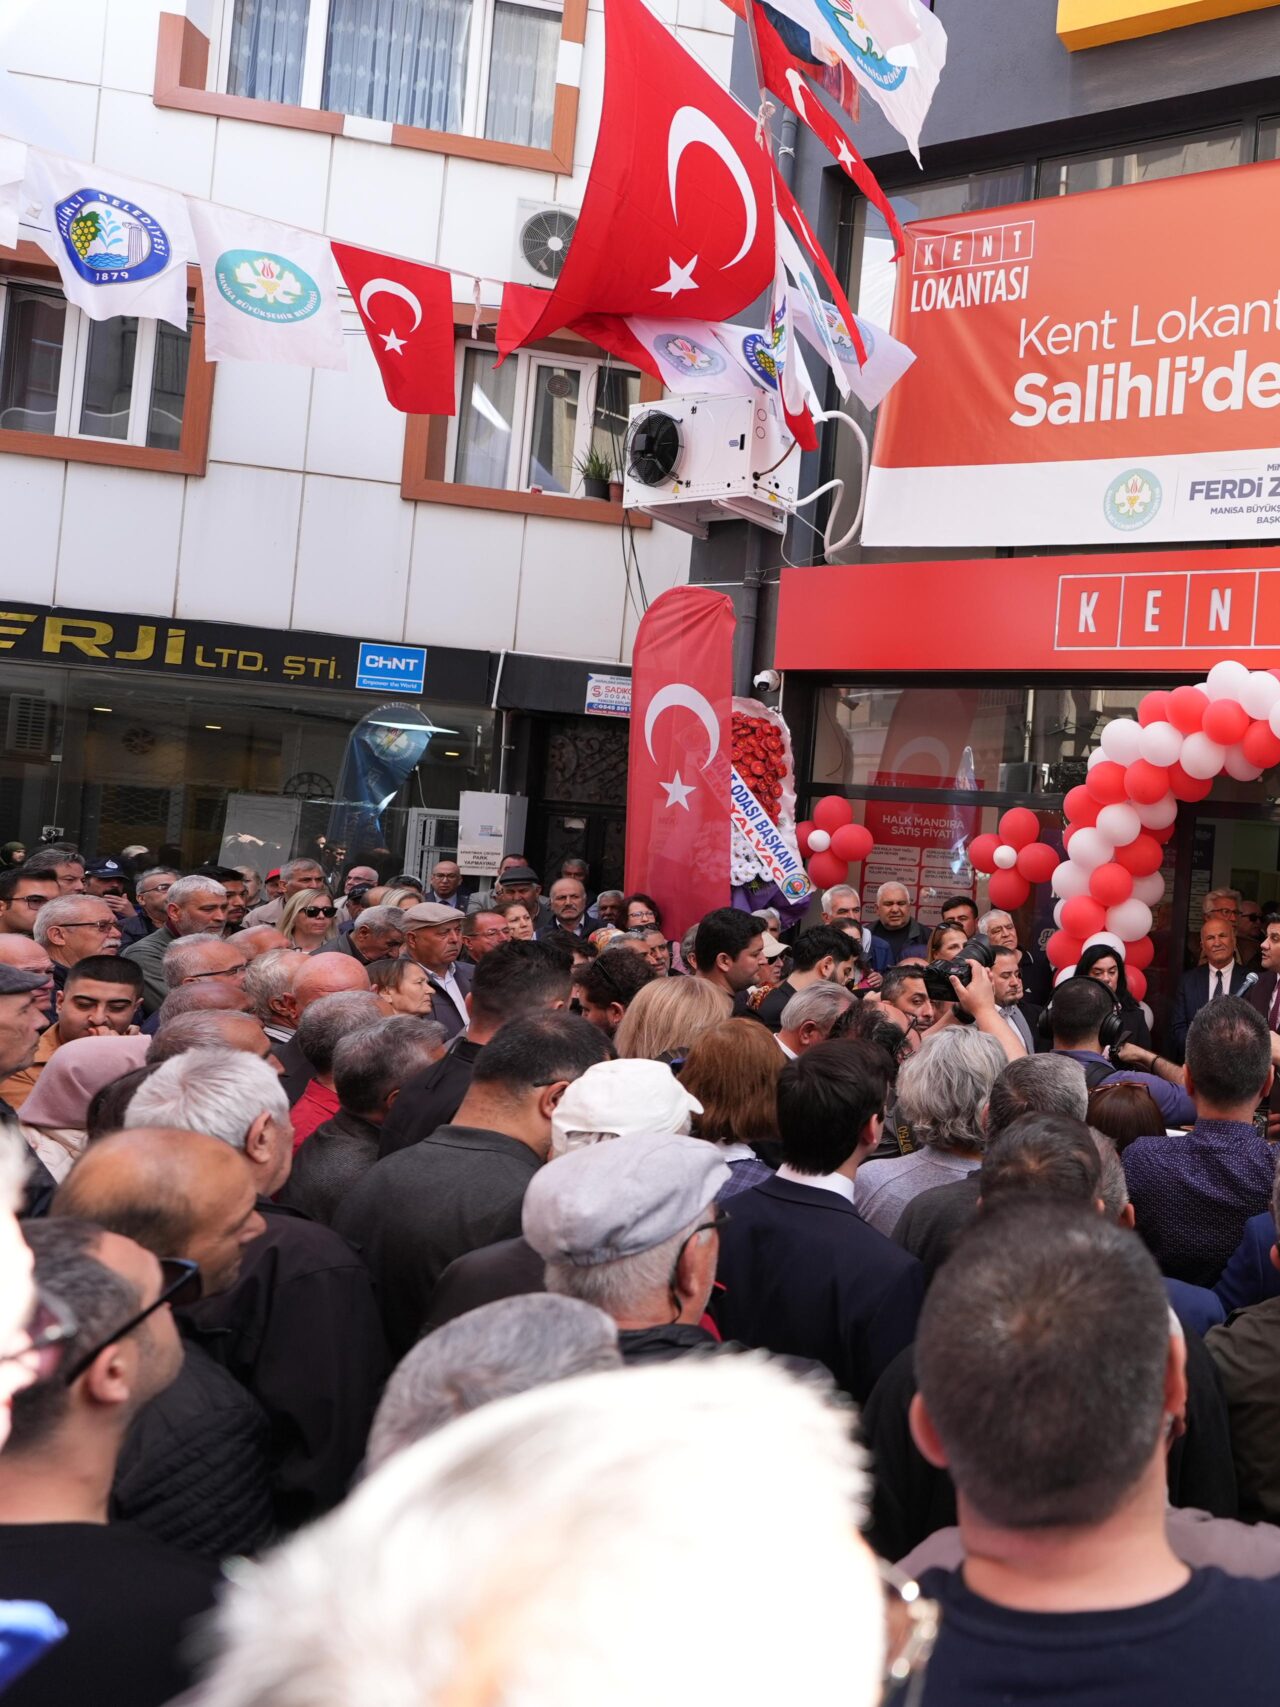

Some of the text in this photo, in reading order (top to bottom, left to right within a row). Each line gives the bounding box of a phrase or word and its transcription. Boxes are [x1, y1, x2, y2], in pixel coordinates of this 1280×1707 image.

[923, 230, 1022, 266] KENT
[95, 271, 129, 281] 1879
[911, 266, 1030, 313] LOKANTASI
[1018, 308, 1118, 359] Kent
[1188, 476, 1264, 501] FERDİ
[1210, 505, 1244, 515] MANİSA
[195, 645, 268, 673] LTD.
[282, 655, 342, 680] ŞTİ.
[731, 784, 763, 821] ODASI
[754, 819, 798, 873] BAŞKANI
[882, 814, 965, 830] HALK MANDIRA
[891, 826, 955, 839] SATIŞ FİYATI
